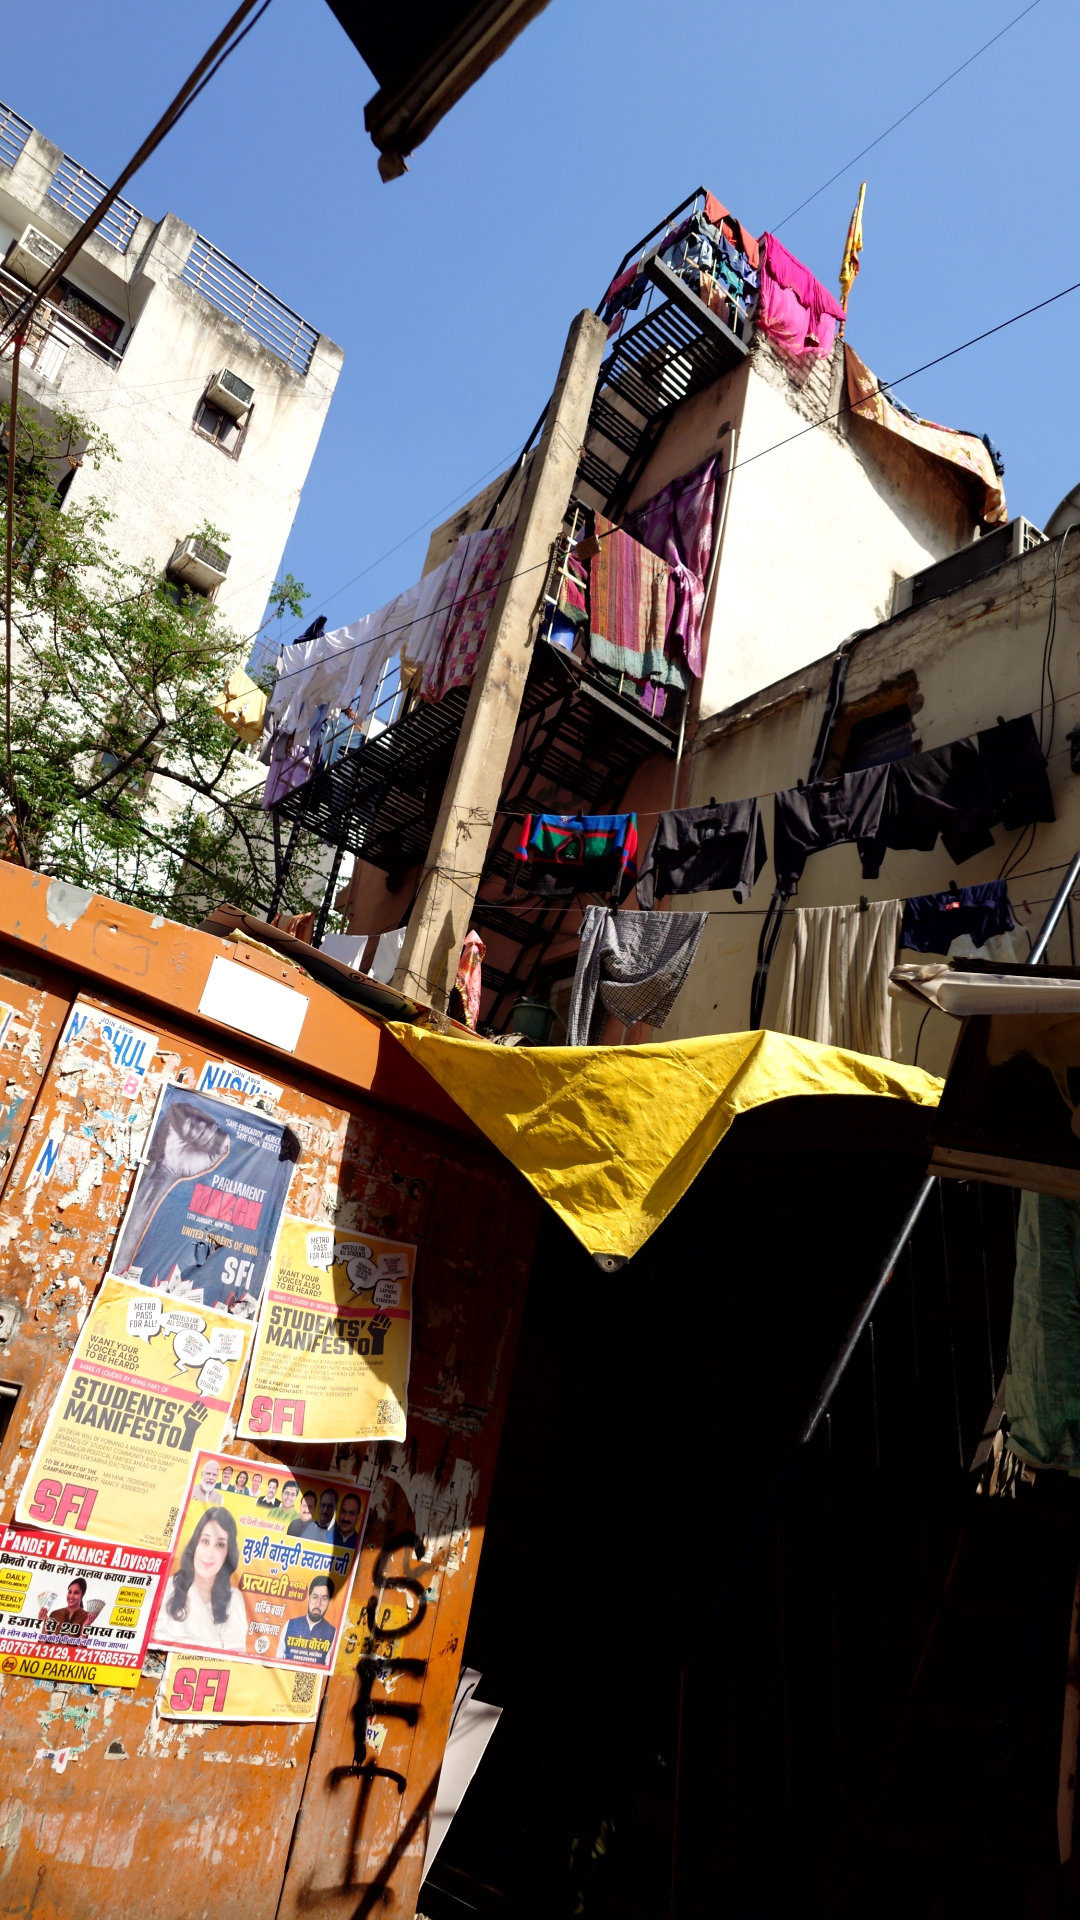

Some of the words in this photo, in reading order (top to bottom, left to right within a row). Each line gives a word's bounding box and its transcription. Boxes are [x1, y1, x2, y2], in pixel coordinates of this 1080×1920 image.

[100, 1017, 115, 1027] JOIN
[232, 1068, 245, 1078] JOIN
[236, 1132, 246, 1142] SAVE
[212, 1174, 266, 1202] PARLIAMENT
[188, 1182, 263, 1231] MARCH
[182, 1226, 203, 1239] UNITED
[205, 1232, 232, 1248] STUDENTS
[234, 1242, 242, 1251] OF
[311, 1236, 329, 1244] METRO
[221, 1256, 255, 1290] SFI
[278, 1275, 302, 1285] VOICES
[303, 1281, 320, 1290] ALSO
[279, 1268, 299, 1277] WANT
[301, 1273, 319, 1283] YOUR
[296, 1286, 322, 1297] HEARD?
[134, 1303, 155, 1311] METRO
[136, 1310, 152, 1319] PASS
[169, 1313, 188, 1322] HOSTELS
[130, 1319, 142, 1328] FOR
[143, 1319, 157, 1328] ALL!
[176, 1320, 199, 1330] STUDENTS
[270, 1305, 366, 1337] STUDENTS'
[90, 1335, 111, 1348] WANT
[112, 1340, 138, 1355] YOUR
[266, 1325, 370, 1355] MANIFESTO
[85, 1350, 96, 1359] TO
[97, 1353, 107, 1362] BE
[108, 1357, 139, 1372] HEARD?
[88, 1342, 116, 1357] VOICES
[117, 1351, 139, 1363] ALSO
[79, 1363, 94, 1372] MAKE
[101, 1368, 122, 1381] LOUDER
[123, 1374, 130, 1382] BY
[130, 1376, 148, 1387] BEING
[149, 1381, 161, 1391] PART
[162, 1384, 168, 1392] OF
[212, 1364, 222, 1373] FREE
[200, 1380, 220, 1394] STUDENTS!
[72, 1376, 184, 1423] STUDENTS'
[63, 1398, 182, 1449] MANIFESTO
[248, 1395, 306, 1436] SFI
[50, 1446, 79, 1458] UPCOMING
[80, 1454, 108, 1465] LOKSABHA
[55, 1433, 81, 1444] DEMANDS
[90, 1442, 112, 1452] STUDENT
[113, 1448, 144, 1460] COMMUNITY
[67, 1443, 86, 1452] MAJOR
[86, 1448, 111, 1458] POLITICAL
[112, 1455, 132, 1464] PARTIES
[133, 1460, 149, 1468] AHEAD
[101, 1438, 124, 1448] FORMING
[130, 1445, 157, 1456] MANIFESTO
[158, 1453, 189, 1464] CONTAINING
[42, 1464, 72, 1476] CAMPAIGN
[72, 1471, 99, 1482] CONTACT:
[29, 1479, 98, 1532] SFI
[1, 1529, 54, 1557] PANDEY
[56, 1538, 110, 1565] FINANCE
[110, 1548, 162, 1573] ADVISOR
[243, 1536, 269, 1563] सुश्री
[269, 1540, 302, 1571] बांसुरी
[301, 1550, 333, 1572] स्वराज
[335, 1552, 350, 1575] जी
[6, 1573, 26, 1581] DAILY
[27, 1560, 37, 1570] पर
[39, 1558, 55, 1573] कैश
[57, 1563, 75, 1577] लोन
[76, 1567, 102, 1580] उपलब्ध
[104, 1571, 126, 1583] कराया
[127, 1575, 145, 1585] जाता
[146, 1575, 153, 1586] है
[120, 1590, 144, 1598] MONTHLY
[241, 1572, 289, 1597] प्रत्याशी
[0, 1593, 23, 1603] EEKLY
[7, 1615, 43, 1630] हजार
[45, 1618, 57, 1632] से
[59, 1622, 79, 1635] 20
[82, 1625, 112, 1638] लाख
[116, 1628, 137, 1640] तक
[116, 1615, 132, 1623] LOAN
[7, 1629, 20, 1638] लोन
[22, 1631, 37, 1640] कराने
[0, 1639, 70, 1662] 8076713129,
[74, 1648, 139, 1668] 7217685572
[19, 1659, 41, 1675] NO
[42, 1663, 97, 1681] PARKING
[170, 1667, 230, 1712] SFI
